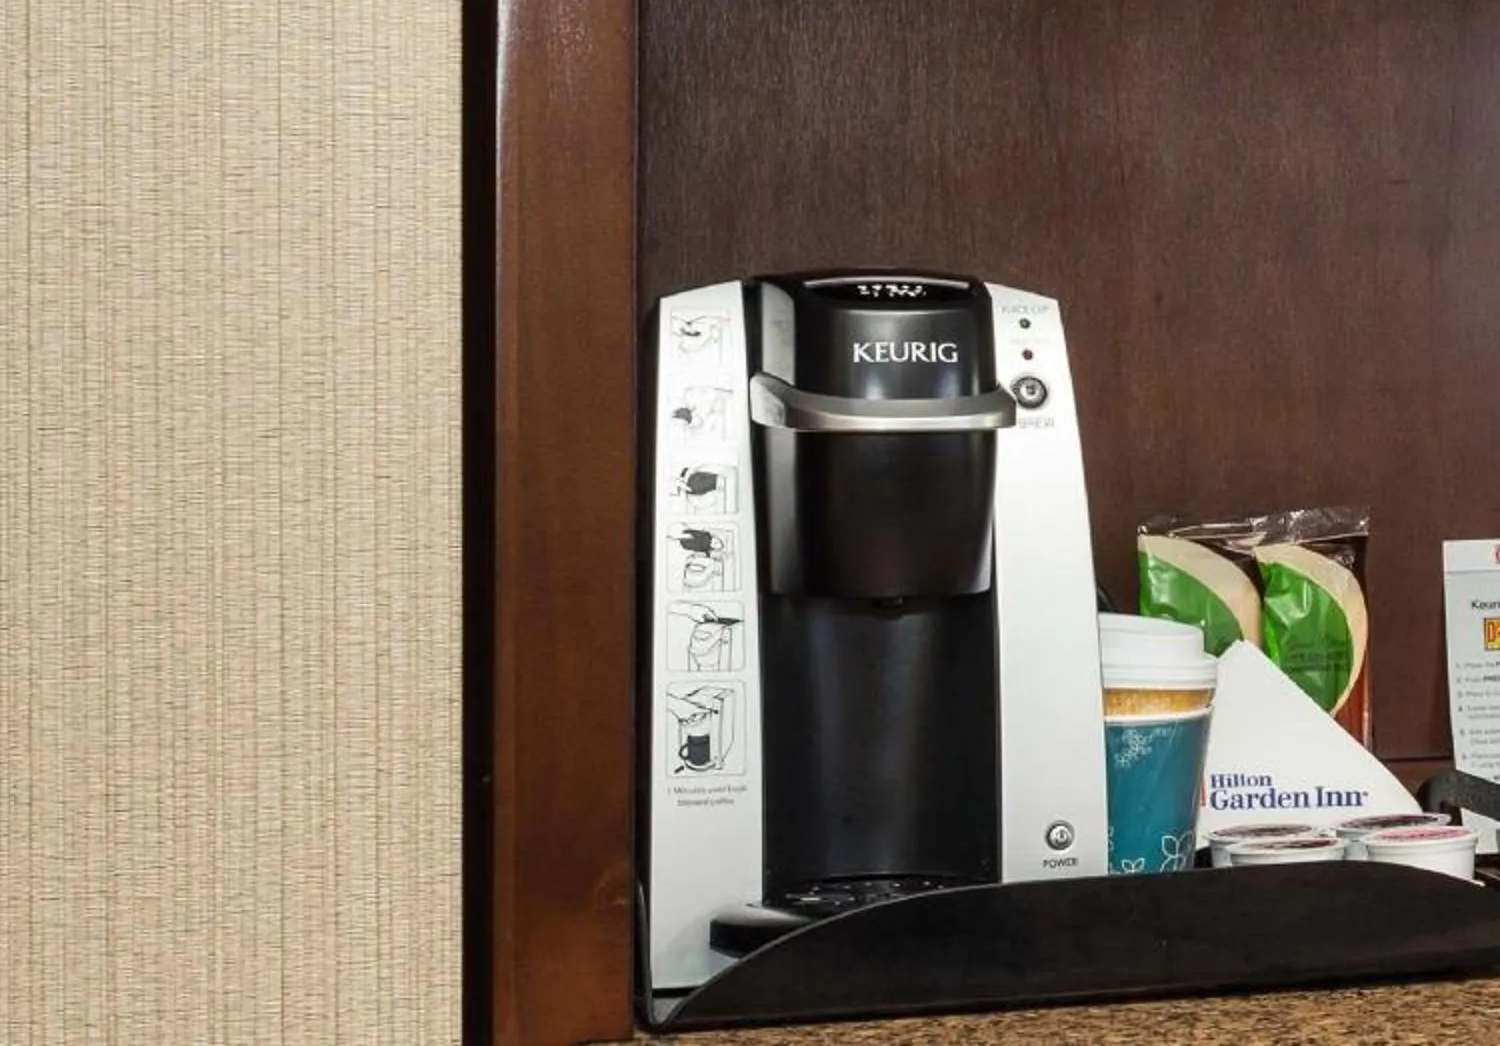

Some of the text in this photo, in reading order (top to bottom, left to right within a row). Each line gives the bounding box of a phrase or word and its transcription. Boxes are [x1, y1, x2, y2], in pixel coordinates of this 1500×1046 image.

[852, 341, 958, 363] KEURIG
[1210, 773, 1272, 788] Hilton
[1209, 786, 1364, 811] Garden Inn
[1043, 857, 1079, 869] POWER
